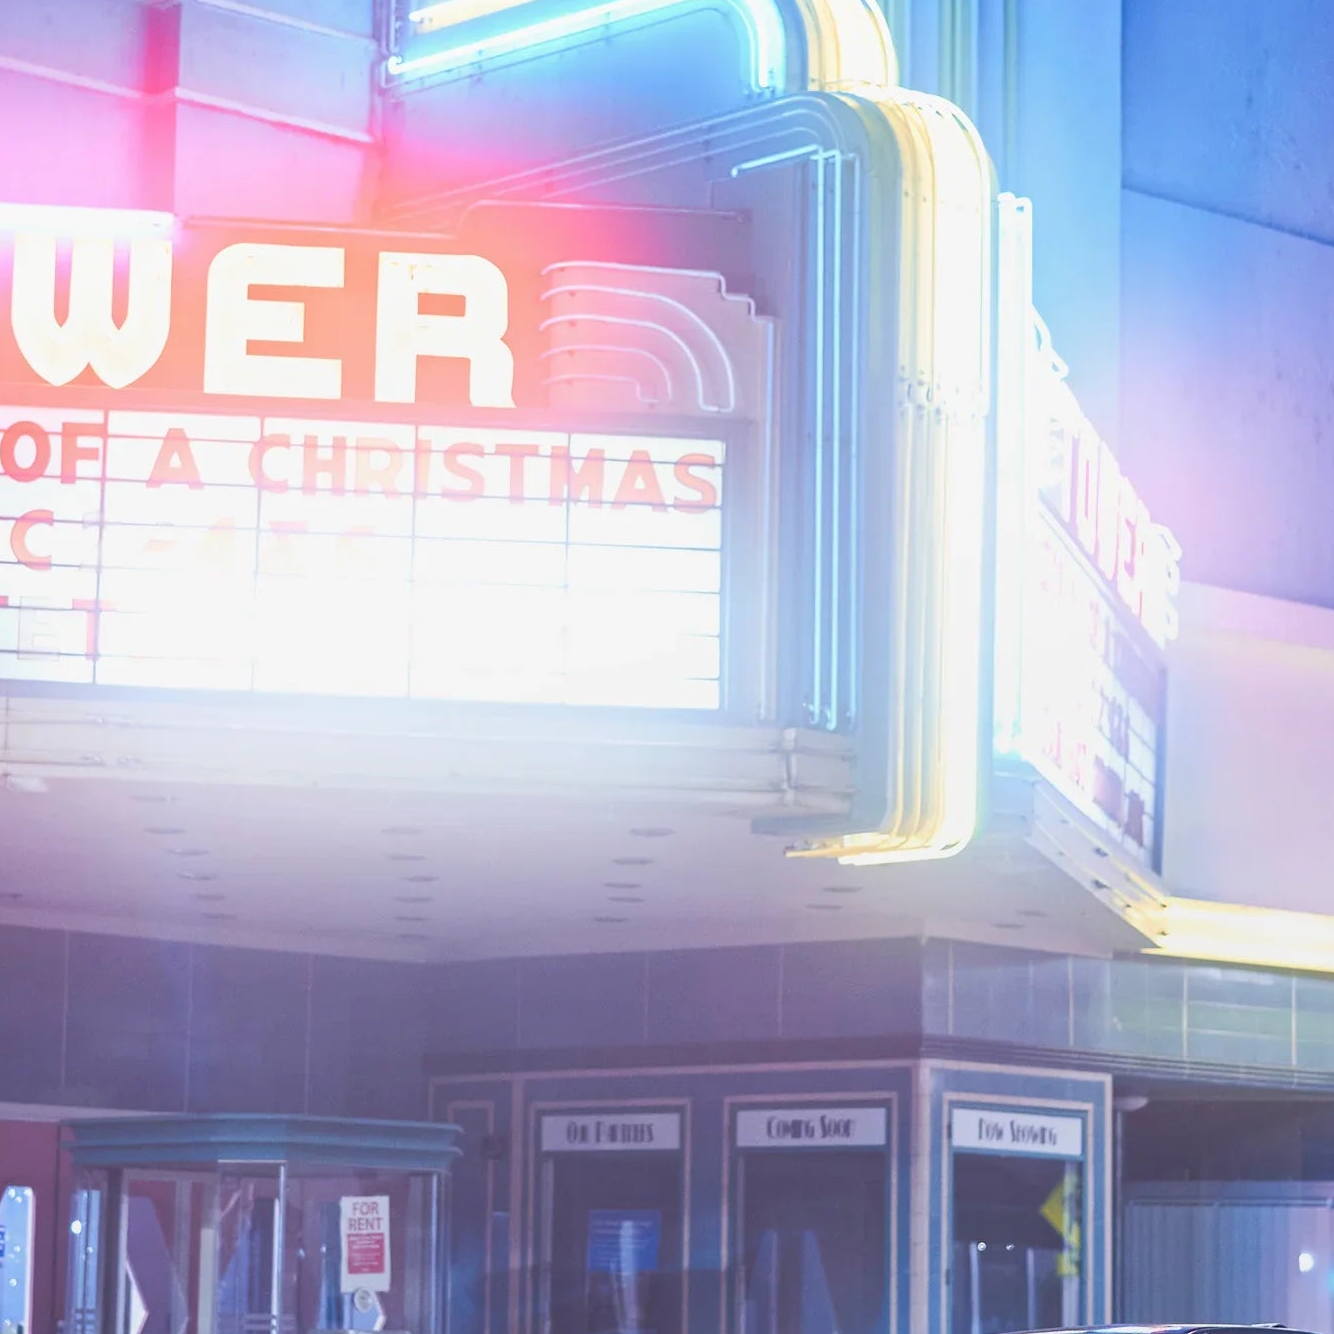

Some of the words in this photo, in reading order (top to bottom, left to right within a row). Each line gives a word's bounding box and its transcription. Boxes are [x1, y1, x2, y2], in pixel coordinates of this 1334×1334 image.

[145, 427, 205, 492] A
[246, 432, 719, 515] CHRISTMAS
[352, 1201, 380, 1216] FOR
[348, 1217, 383, 1232] RENT
